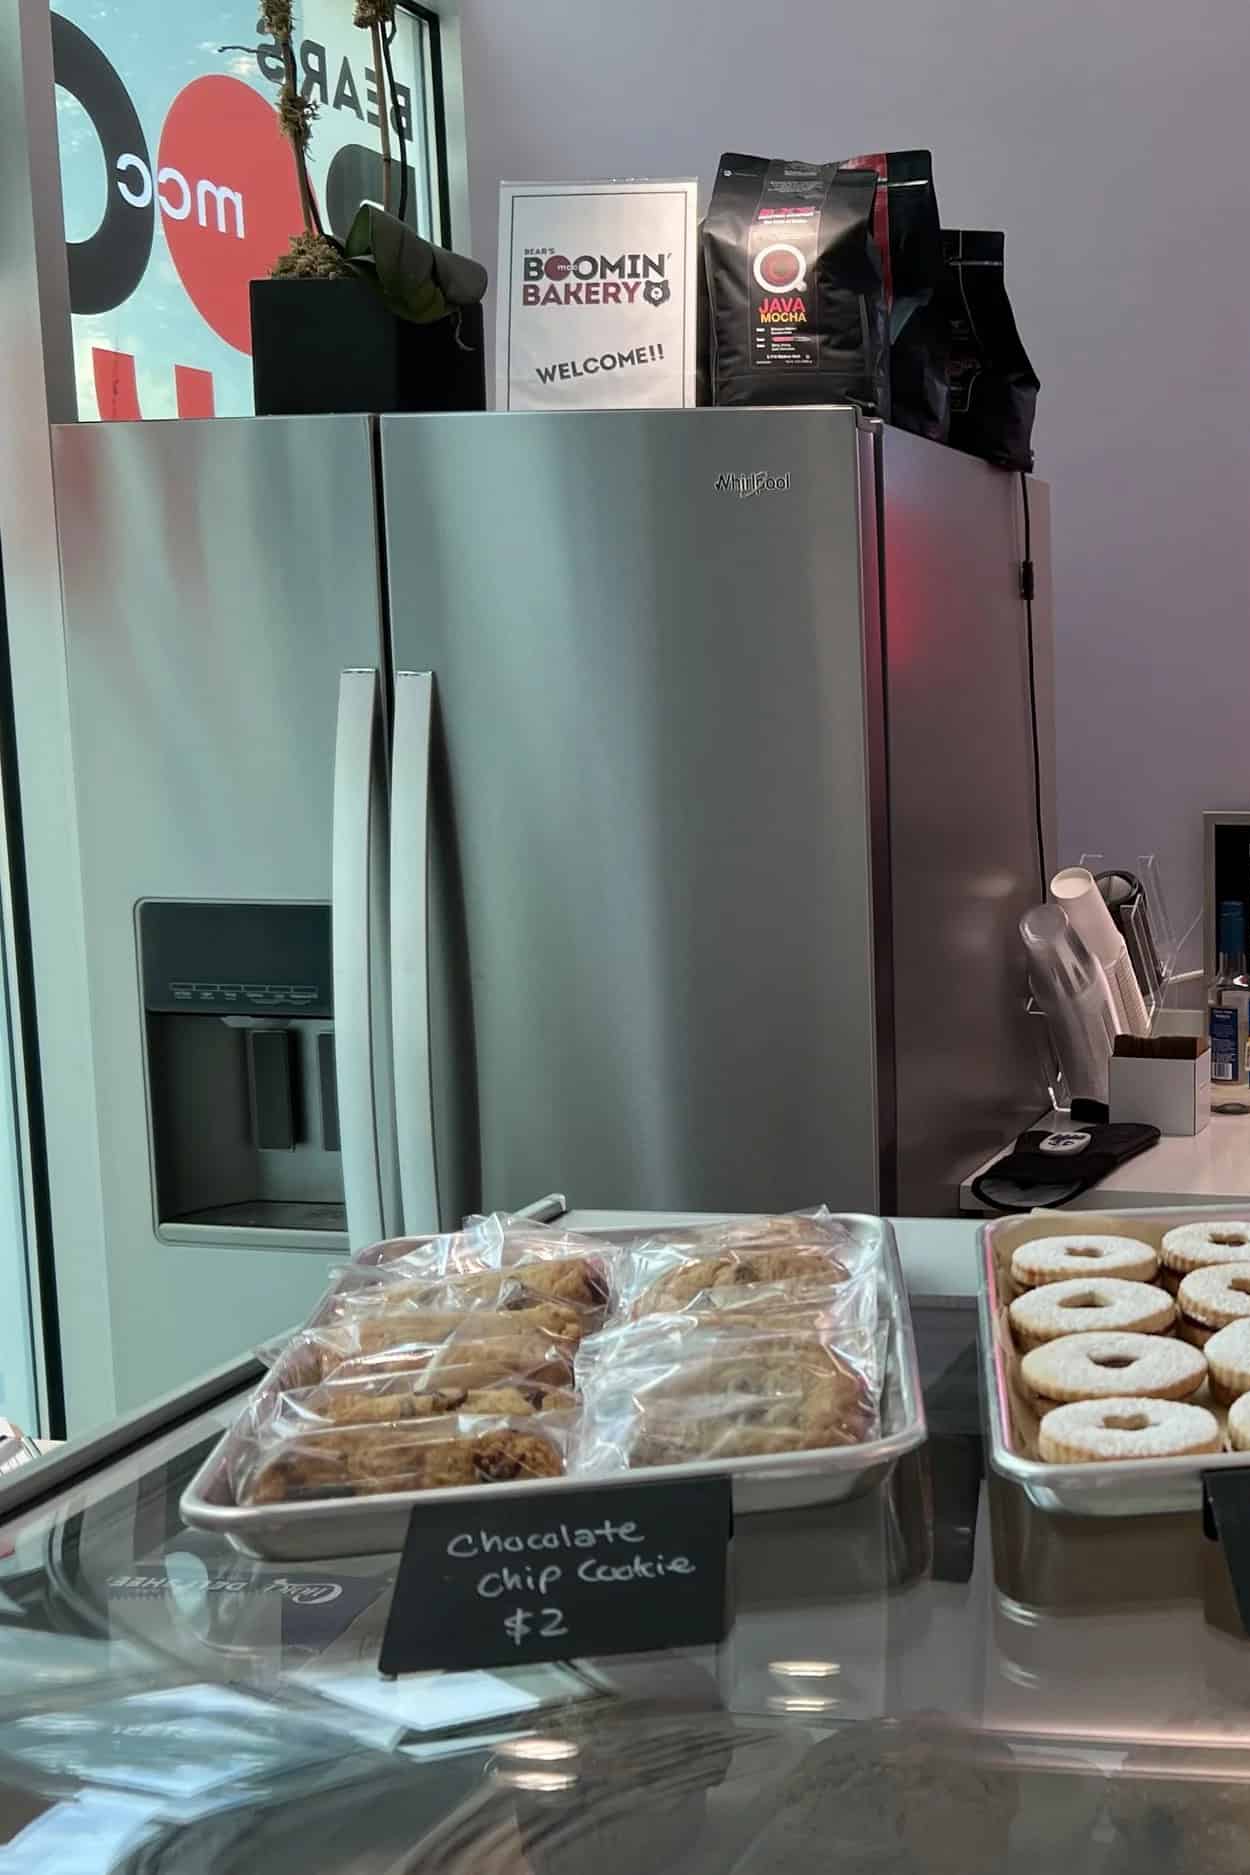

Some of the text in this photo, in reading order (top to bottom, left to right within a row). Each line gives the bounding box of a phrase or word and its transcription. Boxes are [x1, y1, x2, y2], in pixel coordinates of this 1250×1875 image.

[522, 281, 642, 306] BAKERY
[759, 298, 806, 313] JAVA
[760, 312, 807, 323] MOCHA
[536, 343, 664, 384] WELCOME!!
[447, 1520, 645, 1557] Chocolate
[577, 1555, 697, 1583] Cookie
[503, 1608, 568, 1645] $2
